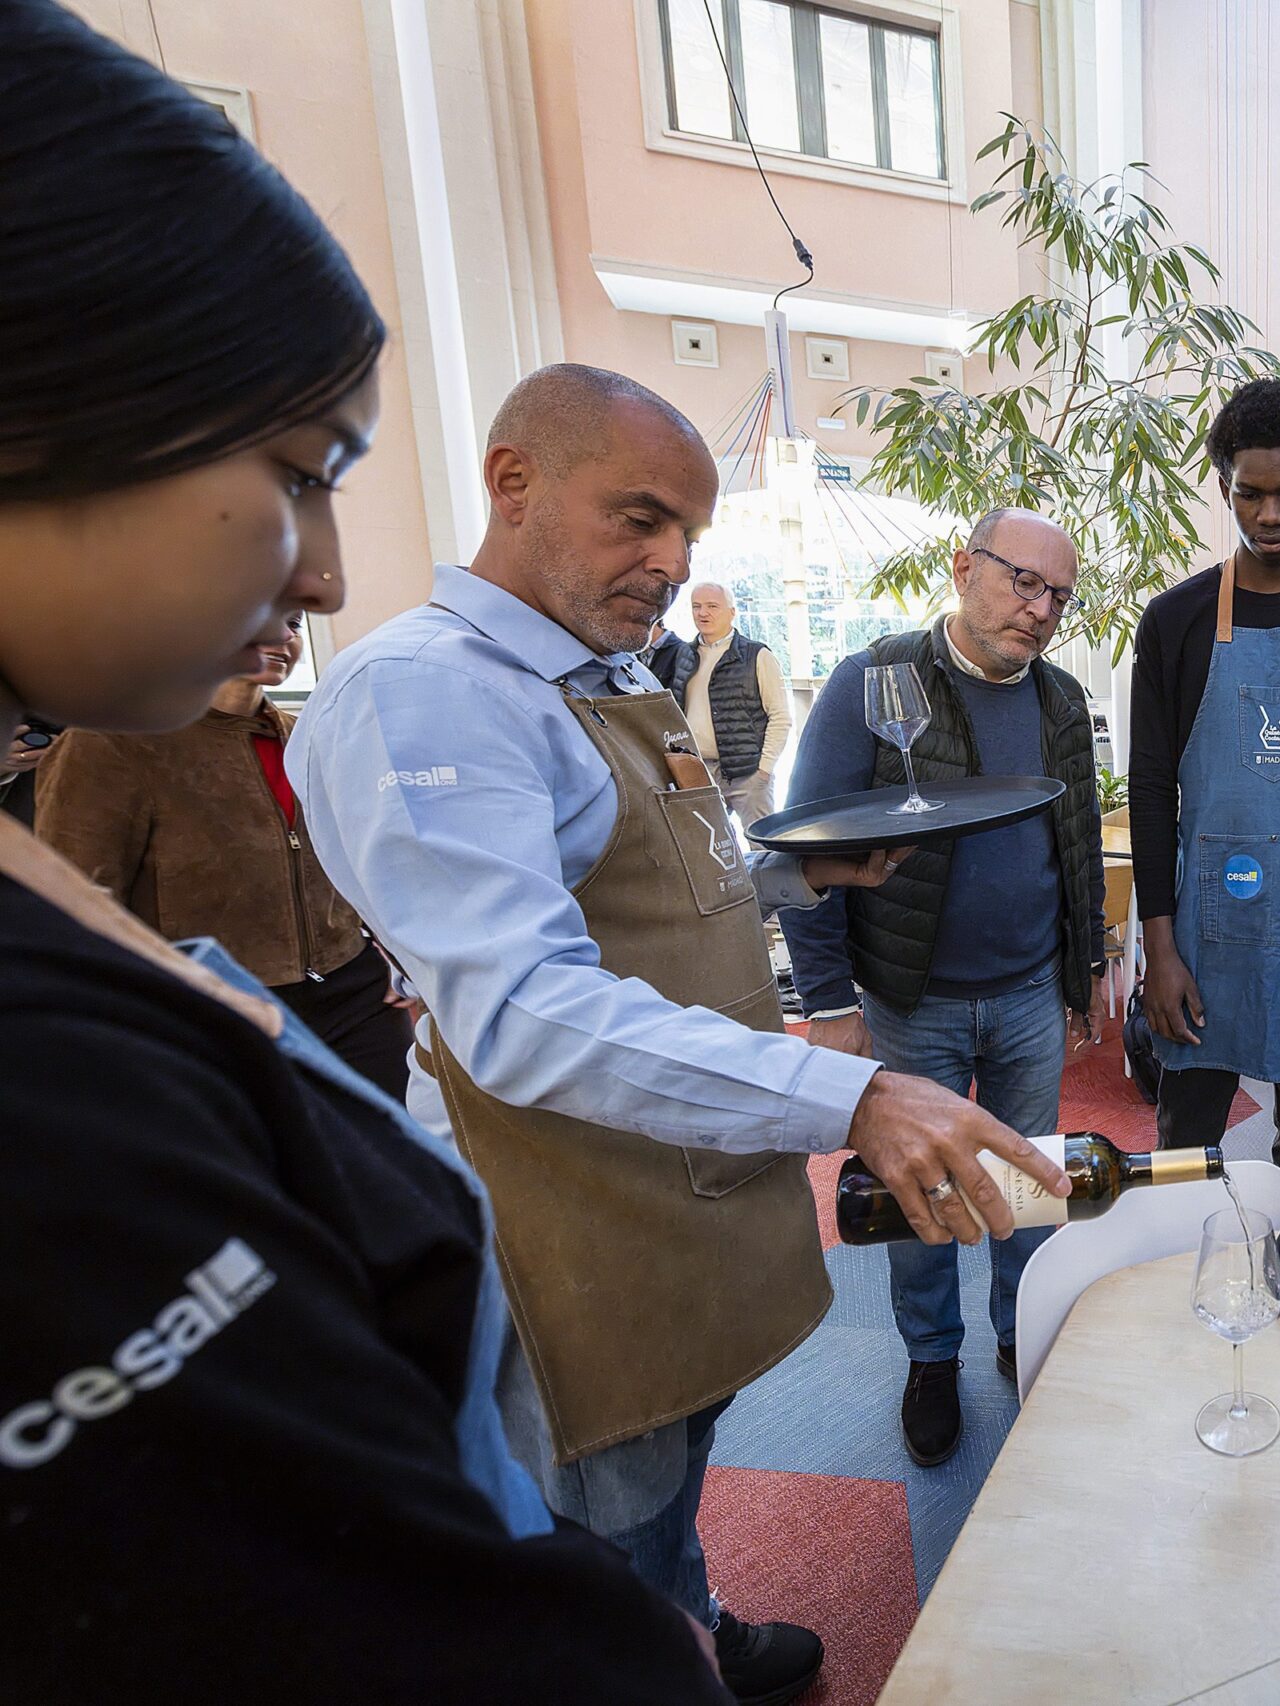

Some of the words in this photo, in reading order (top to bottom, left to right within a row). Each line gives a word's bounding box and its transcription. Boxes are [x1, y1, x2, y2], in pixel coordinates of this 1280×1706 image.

[377, 766, 440, 792] cesal
[1227, 871, 1251, 881] cesal
[0, 1269, 240, 1468] cesal
